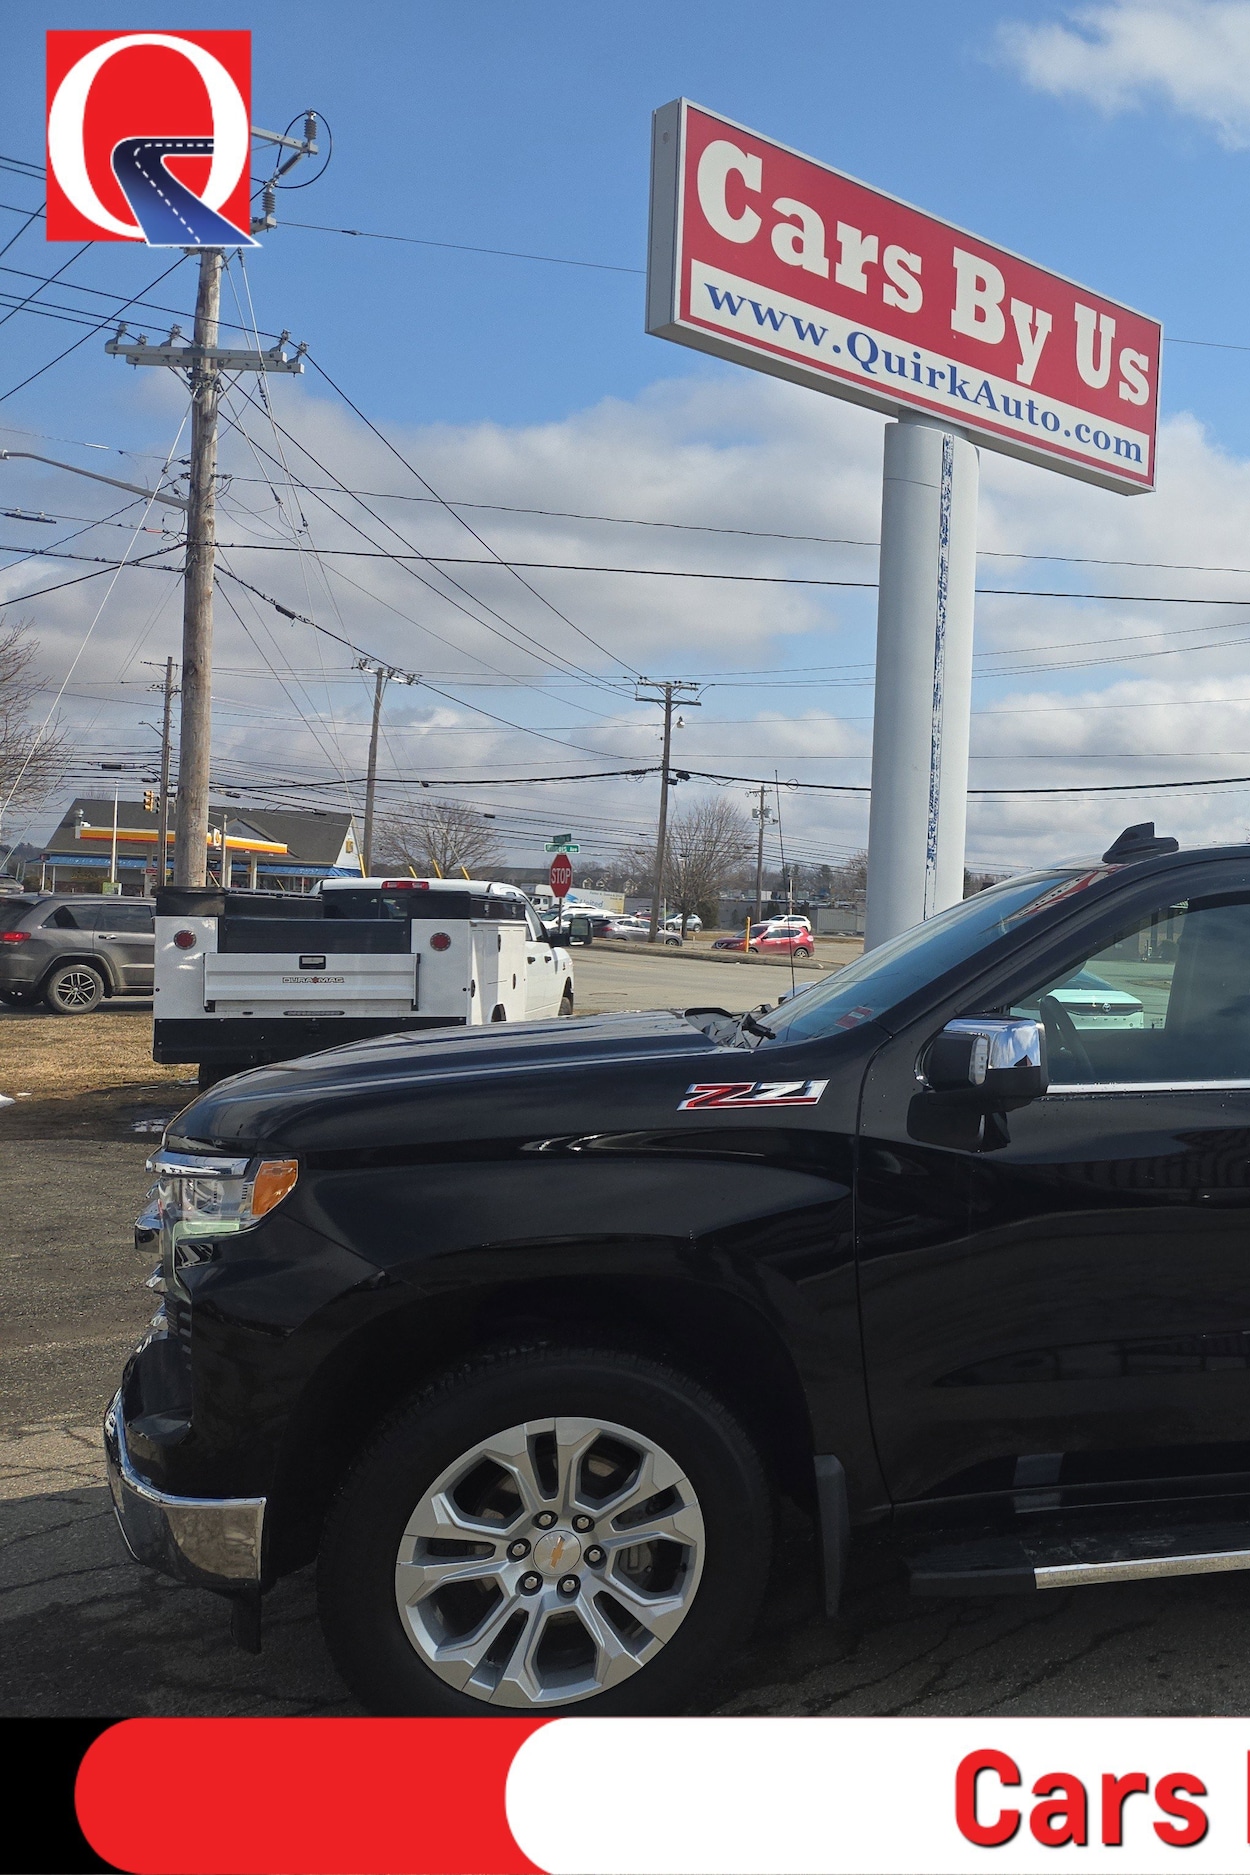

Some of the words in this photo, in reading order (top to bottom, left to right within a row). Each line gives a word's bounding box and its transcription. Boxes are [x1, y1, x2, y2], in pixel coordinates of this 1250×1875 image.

[696, 139, 924, 314] Cars
[951, 246, 1053, 386] By
[1074, 301, 1150, 406] Us
[703, 282, 1144, 464] www.QuirkAuto.com
[551, 867, 571, 884] STOP
[676, 1079, 830, 1111] Z71
